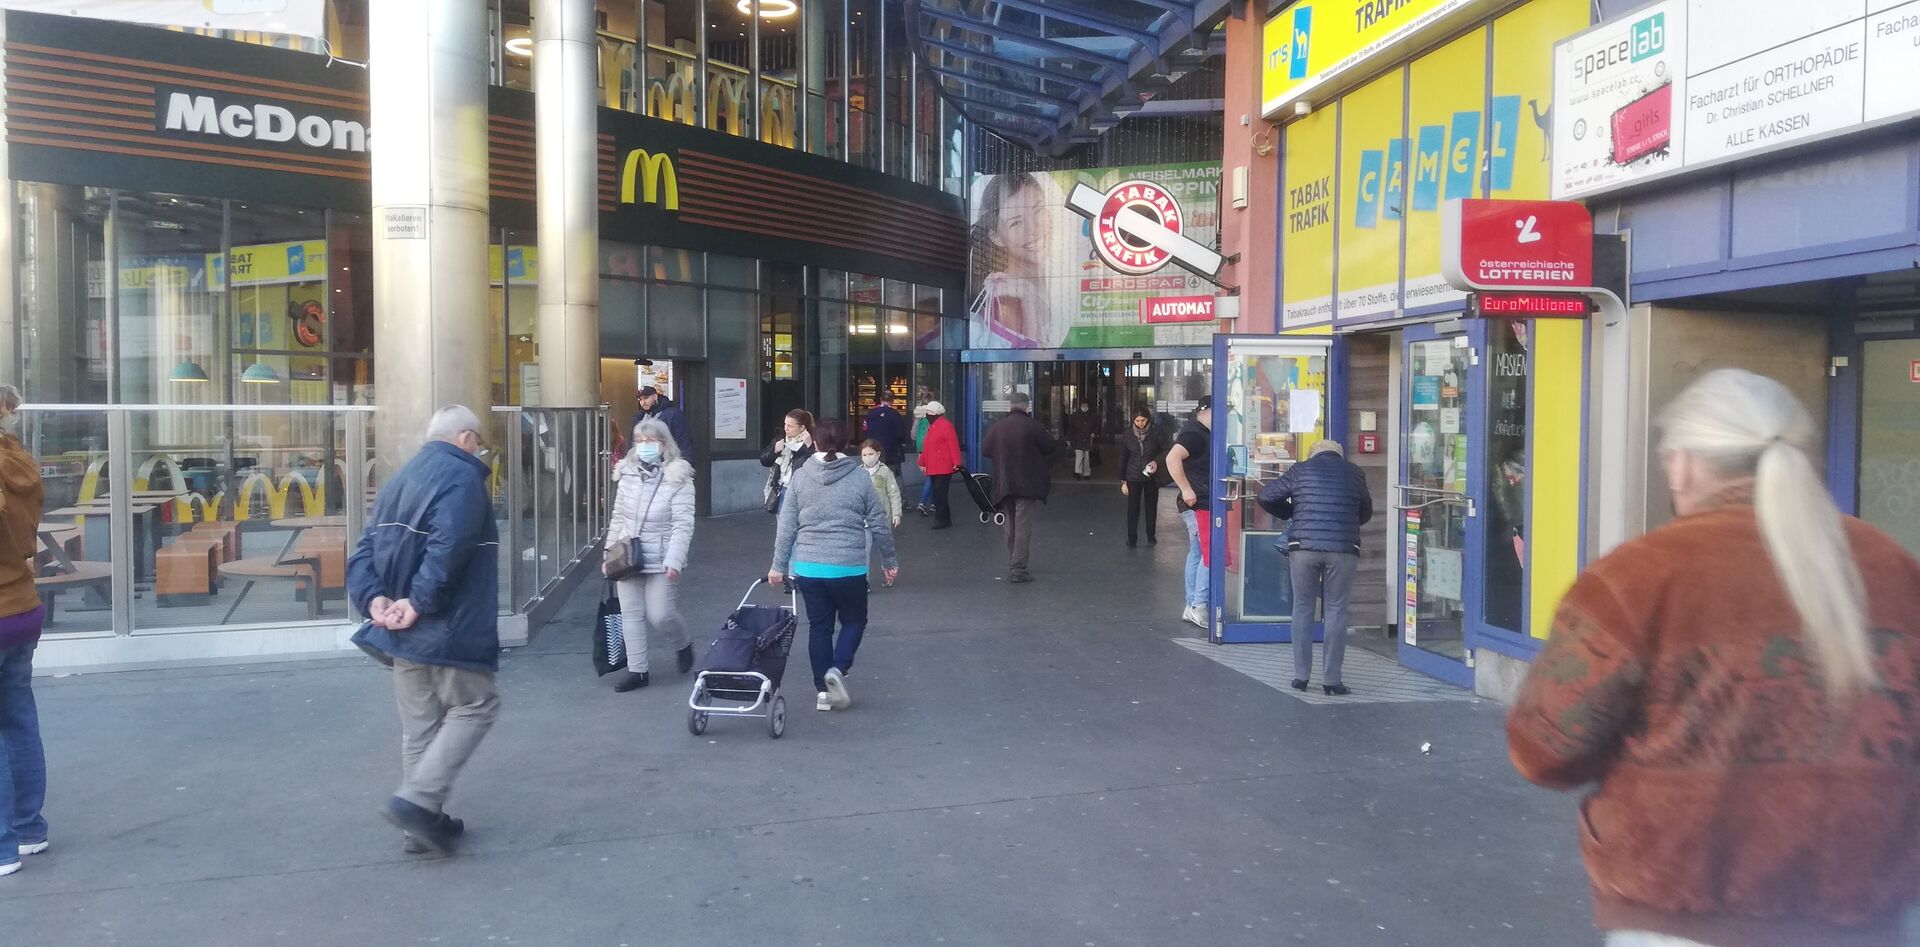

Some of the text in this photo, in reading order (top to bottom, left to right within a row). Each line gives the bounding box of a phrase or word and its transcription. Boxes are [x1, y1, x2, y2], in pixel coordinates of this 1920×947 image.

[1877, 15, 1920, 38] Facha
[1268, 44, 1288, 70] IT'S
[1690, 42, 1859, 110] Facharzt für ORTHOPÄDIE
[1706, 75, 1834, 124] Dr. Christian SCHELLNER
[1726, 113, 1810, 148] ALLE KASSEN
[1115, 186, 1177, 223] TABAK
[1290, 176, 1330, 209] TABAK
[1290, 202, 1330, 234] TRAFIK
[1102, 216, 1159, 265] TRAFIK
[1480, 259, 1574, 269] österreichische
[1480, 269, 1574, 280] LOTTERIEN
[1089, 278, 1184, 290] EUROSPAR
[1152, 301, 1213, 317] AUTOMAT
[1287, 305, 1317, 320] Tabakrauch
[1343, 297, 1357, 310] über
[1358, 295, 1366, 307] 70
[1367, 291, 1389, 305] Stoffe,
[1405, 282, 1455, 299] erwiesenerm
[1484, 297, 1583, 311] EuroMillionen
[1495, 352, 1527, 376] MASKEN
